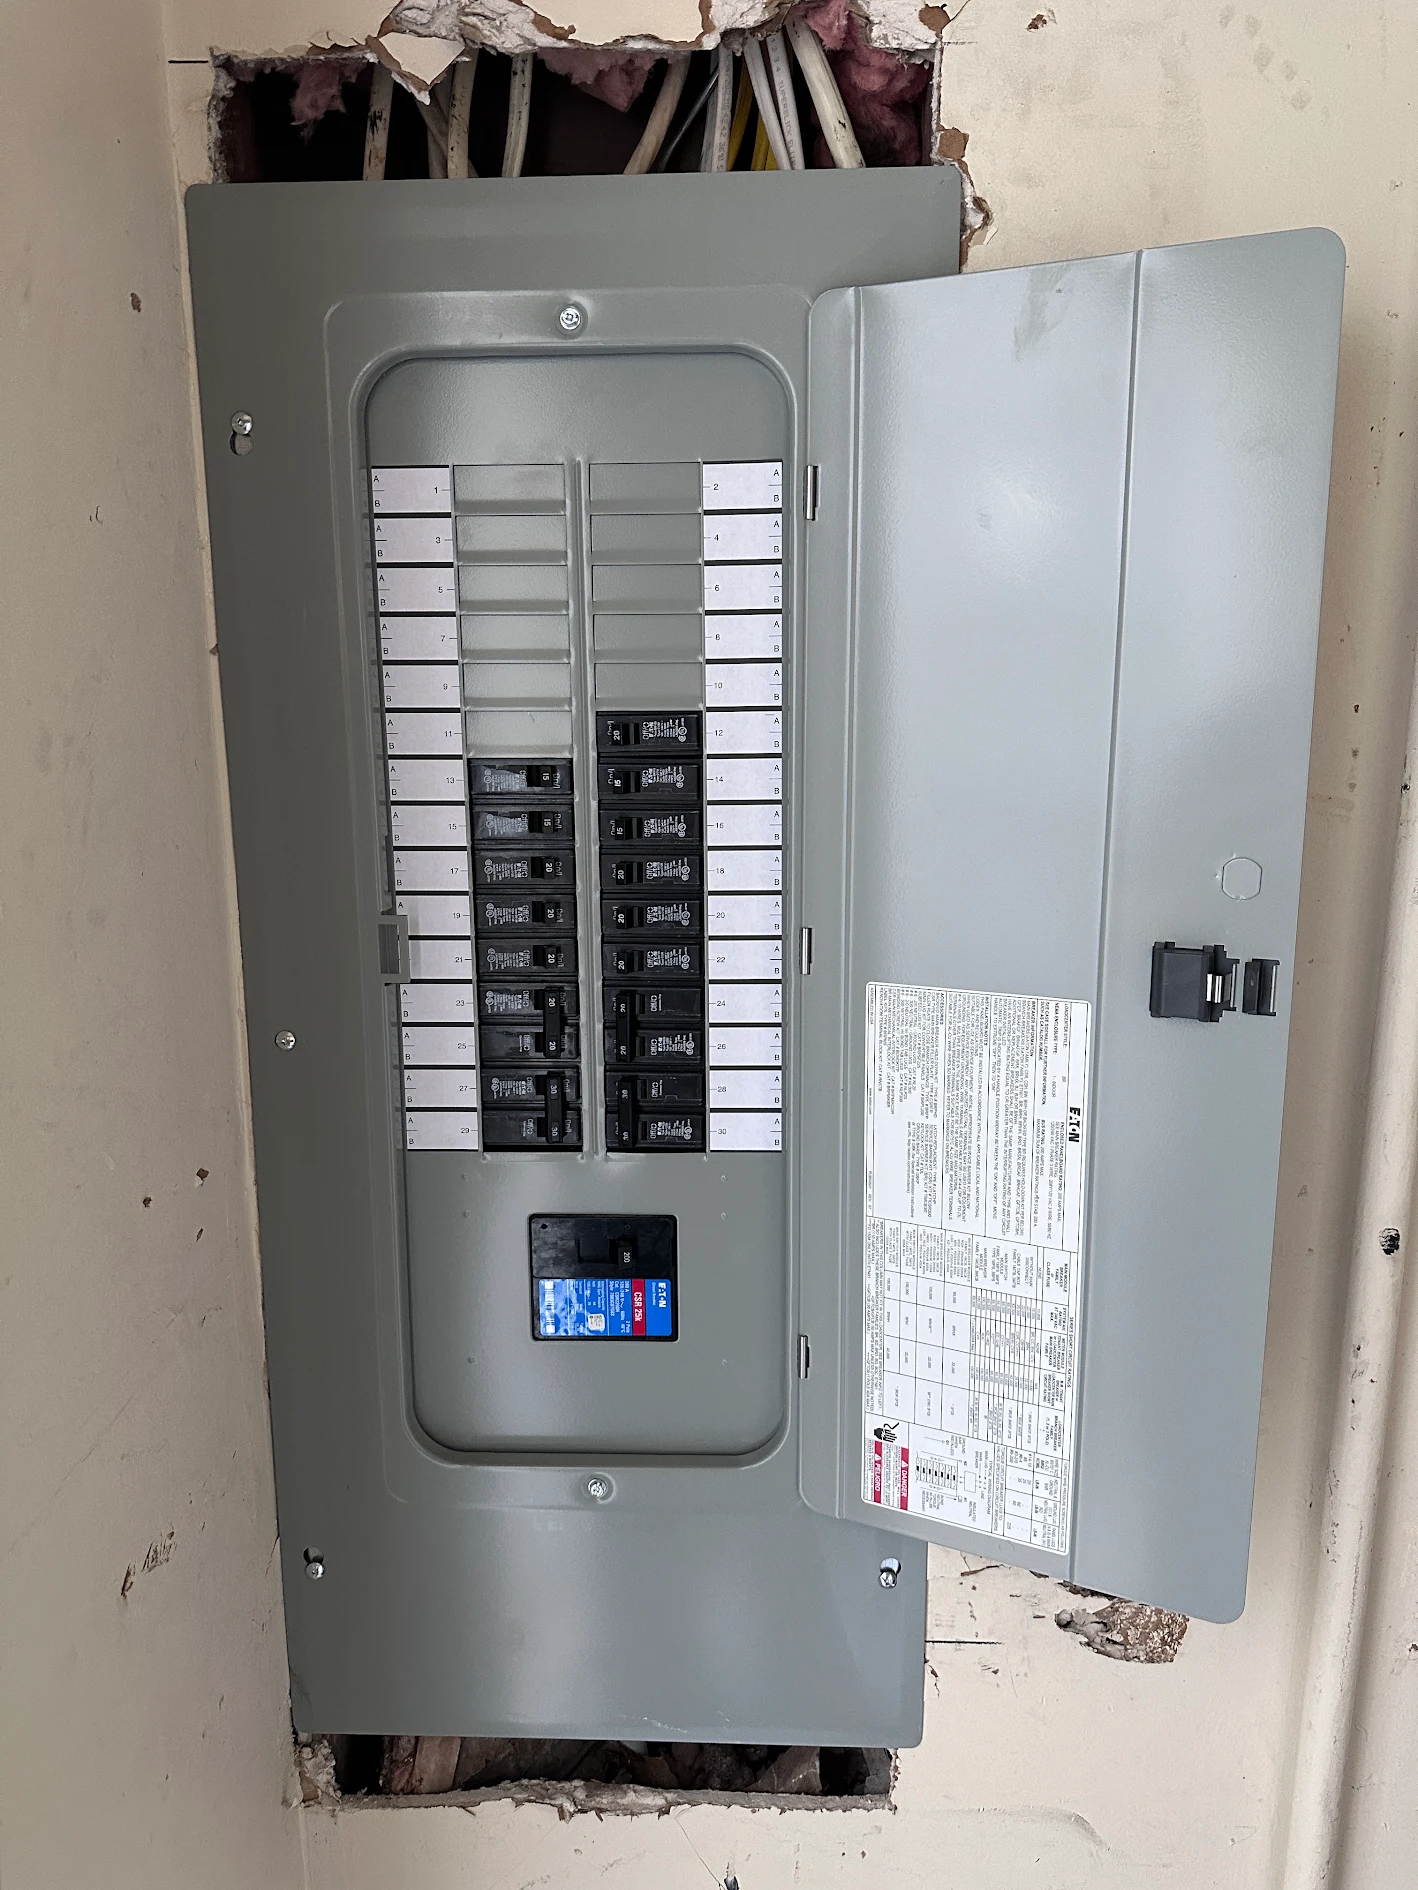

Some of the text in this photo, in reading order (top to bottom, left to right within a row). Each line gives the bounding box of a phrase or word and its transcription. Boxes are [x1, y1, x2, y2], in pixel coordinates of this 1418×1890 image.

[614, 730, 620, 741] 20
[542, 772, 550, 781] 15
[543, 818, 551, 826] 15
[617, 827, 623, 835] 15
[545, 862, 553, 873] 20
[618, 870, 624, 880] 20
[547, 908, 555, 918] 20
[618, 914, 624, 924] 20
[548, 954, 555, 964] 20
[618, 960, 625, 970] 20
[548, 997, 556, 1007] 20
[620, 1003, 626, 1013] 20
[549, 1041, 556, 1050] 20
[620, 1046, 626, 1055] 20
[550, 1085, 558, 1094] 30
[622, 1089, 628, 1099] 30
[551, 1126, 558, 1136] 30
[623, 1131, 629, 1141] 30
[634, 1292, 642, 1322] CSR 25k
